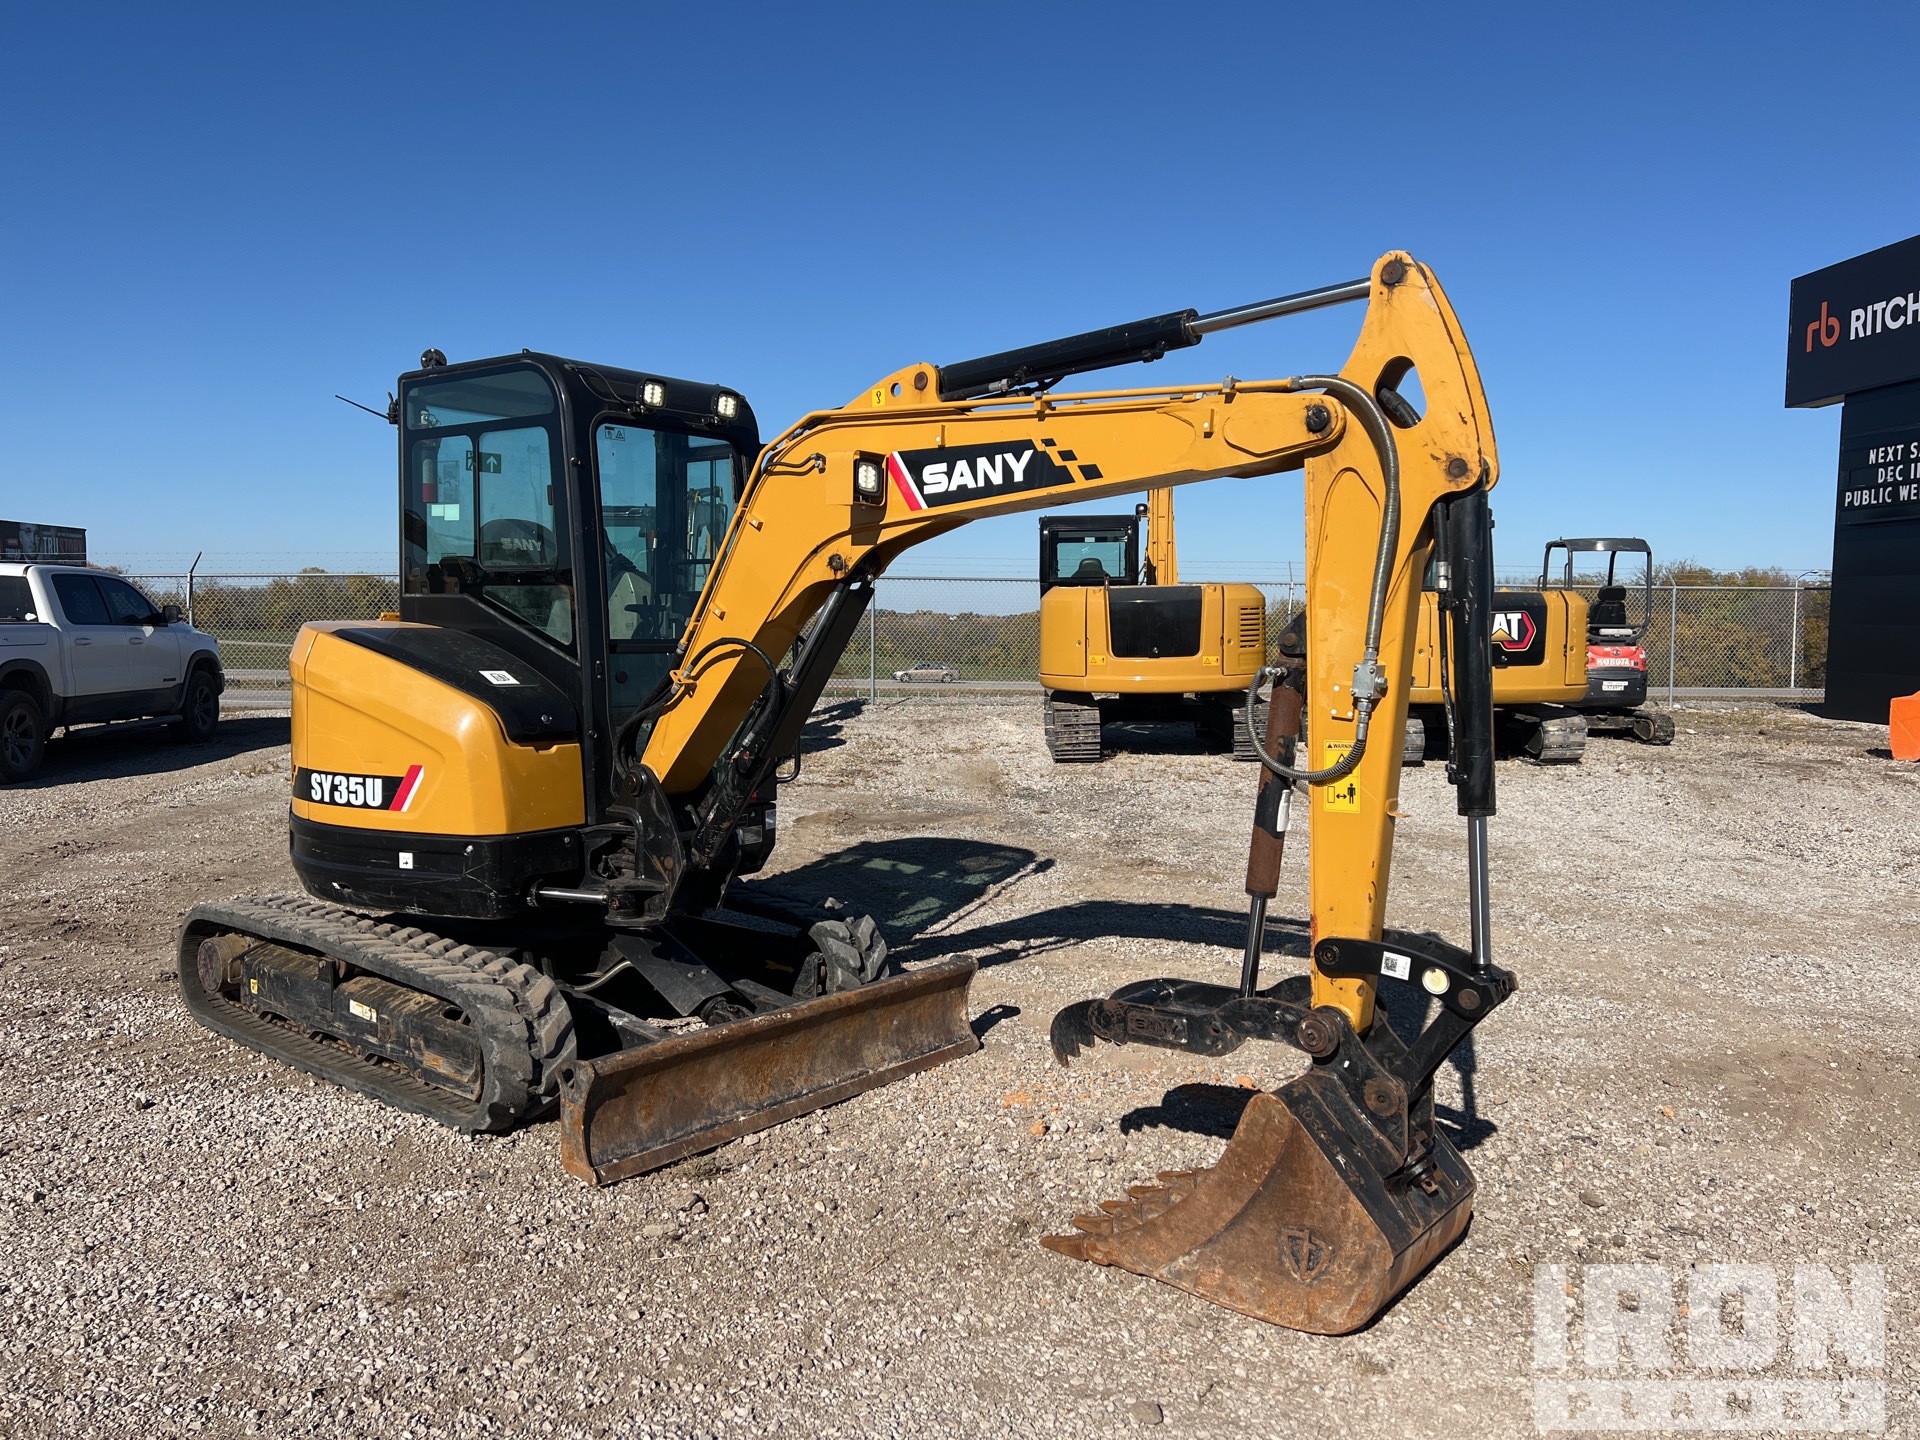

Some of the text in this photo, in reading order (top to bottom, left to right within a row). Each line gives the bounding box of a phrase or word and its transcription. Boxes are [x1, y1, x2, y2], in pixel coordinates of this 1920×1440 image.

[1849, 290, 1920, 341] RITCH
[1868, 441, 1920, 465] NEXT S
[922, 449, 1034, 495] SANY
[1877, 464, 1904, 484] DEC
[1844, 483, 1920, 507] PUBLIC WE
[500, 537, 542, 552] SANY
[1490, 612, 1523, 641] AT
[310, 772, 383, 807] SY35U
